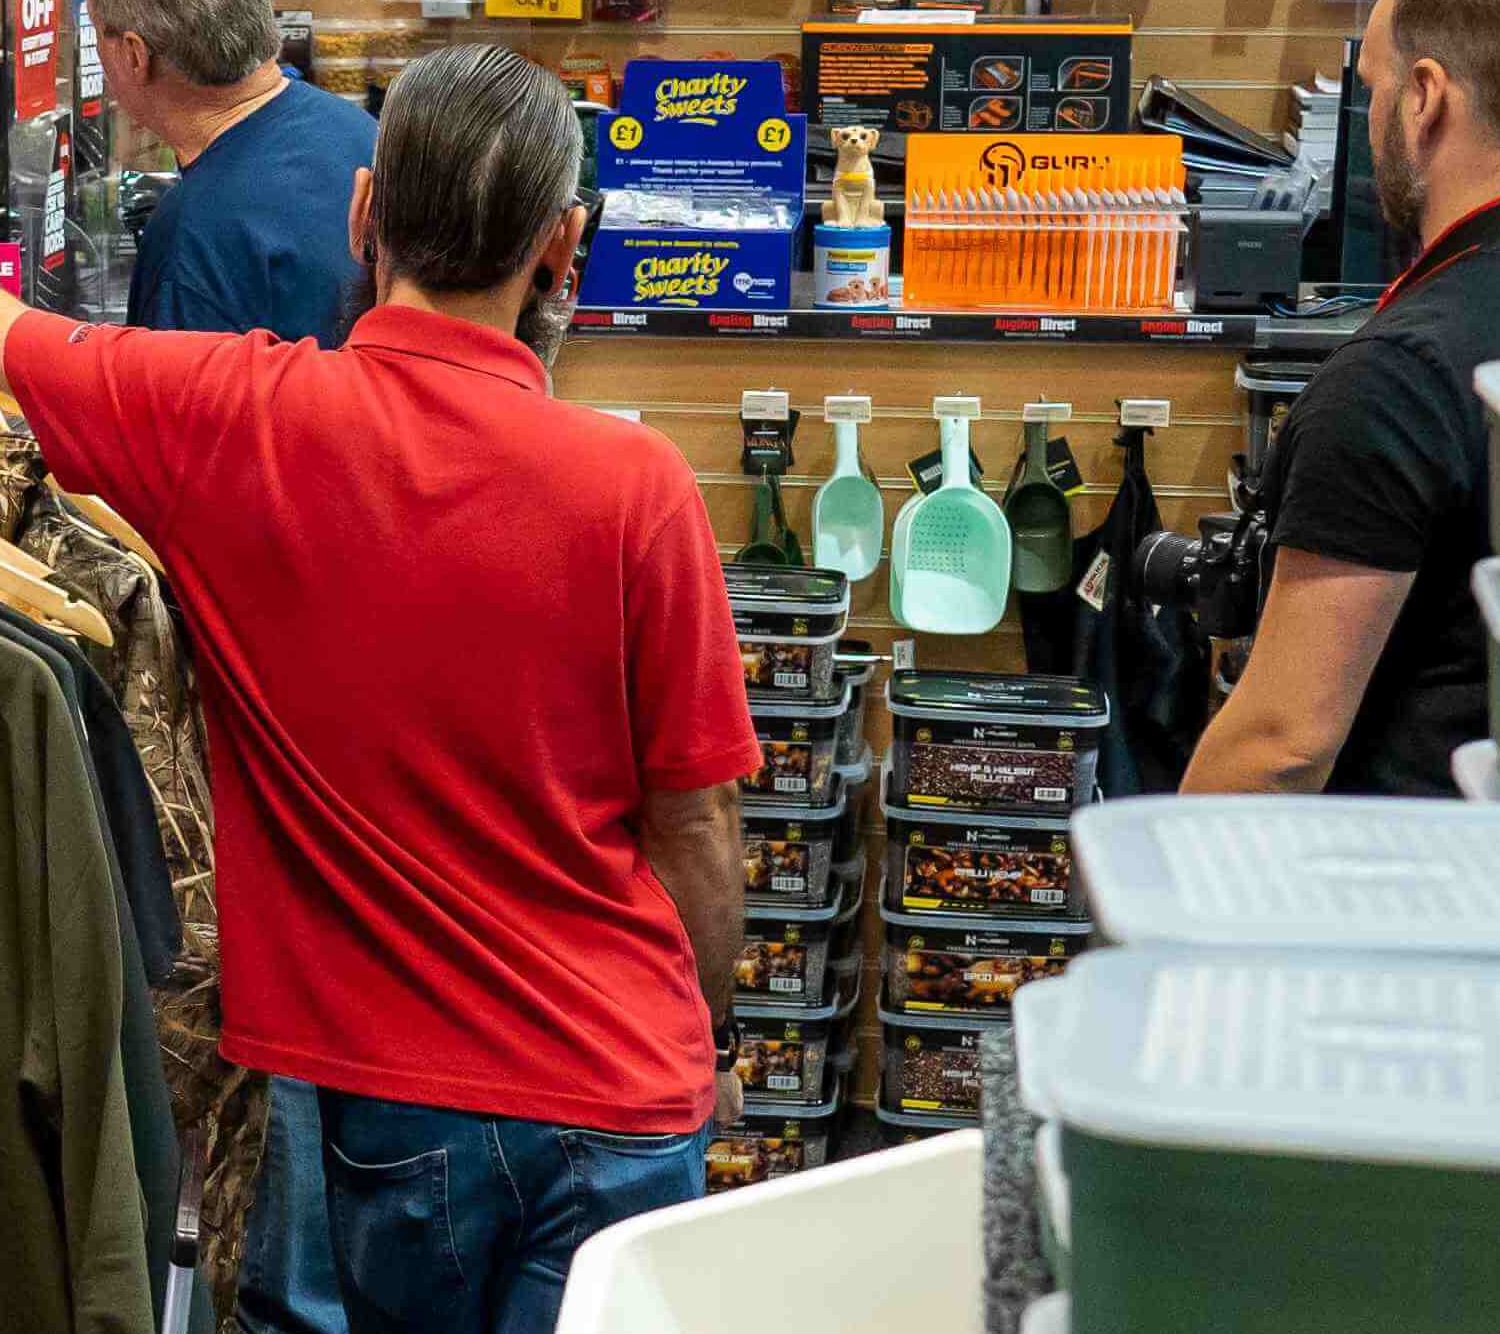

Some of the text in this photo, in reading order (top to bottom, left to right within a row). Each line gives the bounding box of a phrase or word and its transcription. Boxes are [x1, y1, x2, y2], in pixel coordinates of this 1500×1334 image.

[655, 73, 747, 98] Charity
[654, 96, 738, 121] Sweets
[616, 126, 637, 141] £1
[764, 126, 785, 142] £1
[634, 252, 728, 277] Charity
[633, 275, 720, 304] Sweets
[613, 313, 647, 326] Direct
[753, 314, 789, 327] Direct
[896, 316, 931, 330] Direct
[1040, 319, 1075, 332] Direct
[1187, 322, 1223, 334] Direct
